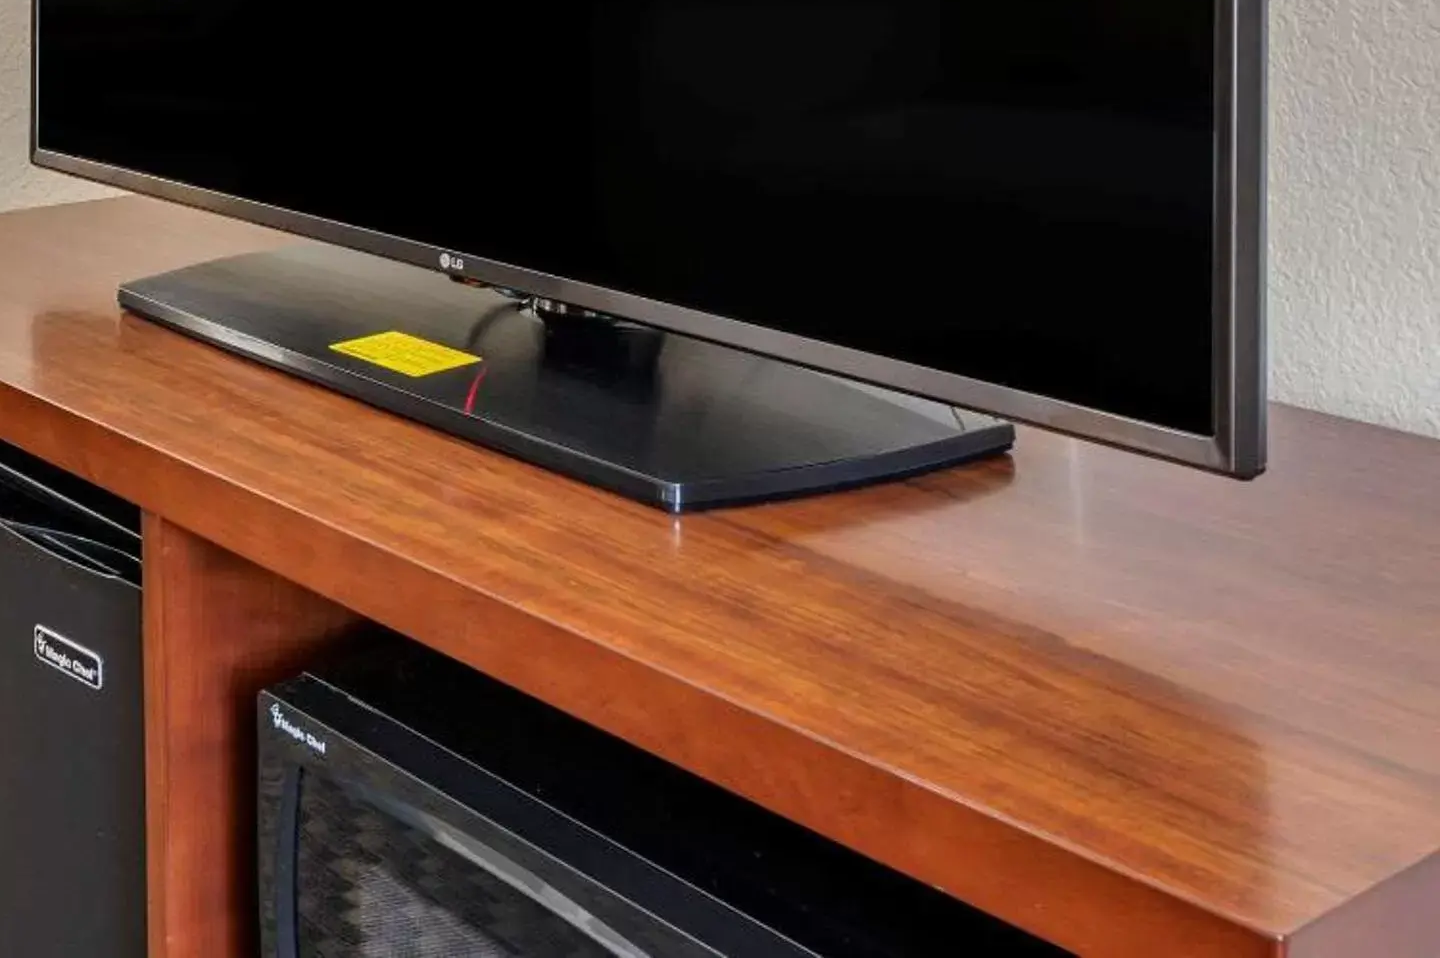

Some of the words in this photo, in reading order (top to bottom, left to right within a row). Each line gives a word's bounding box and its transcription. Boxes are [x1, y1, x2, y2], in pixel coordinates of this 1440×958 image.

[450, 256, 464, 270] LG
[45, 645, 72, 669] Magic
[72, 659, 94, 680] Chef
